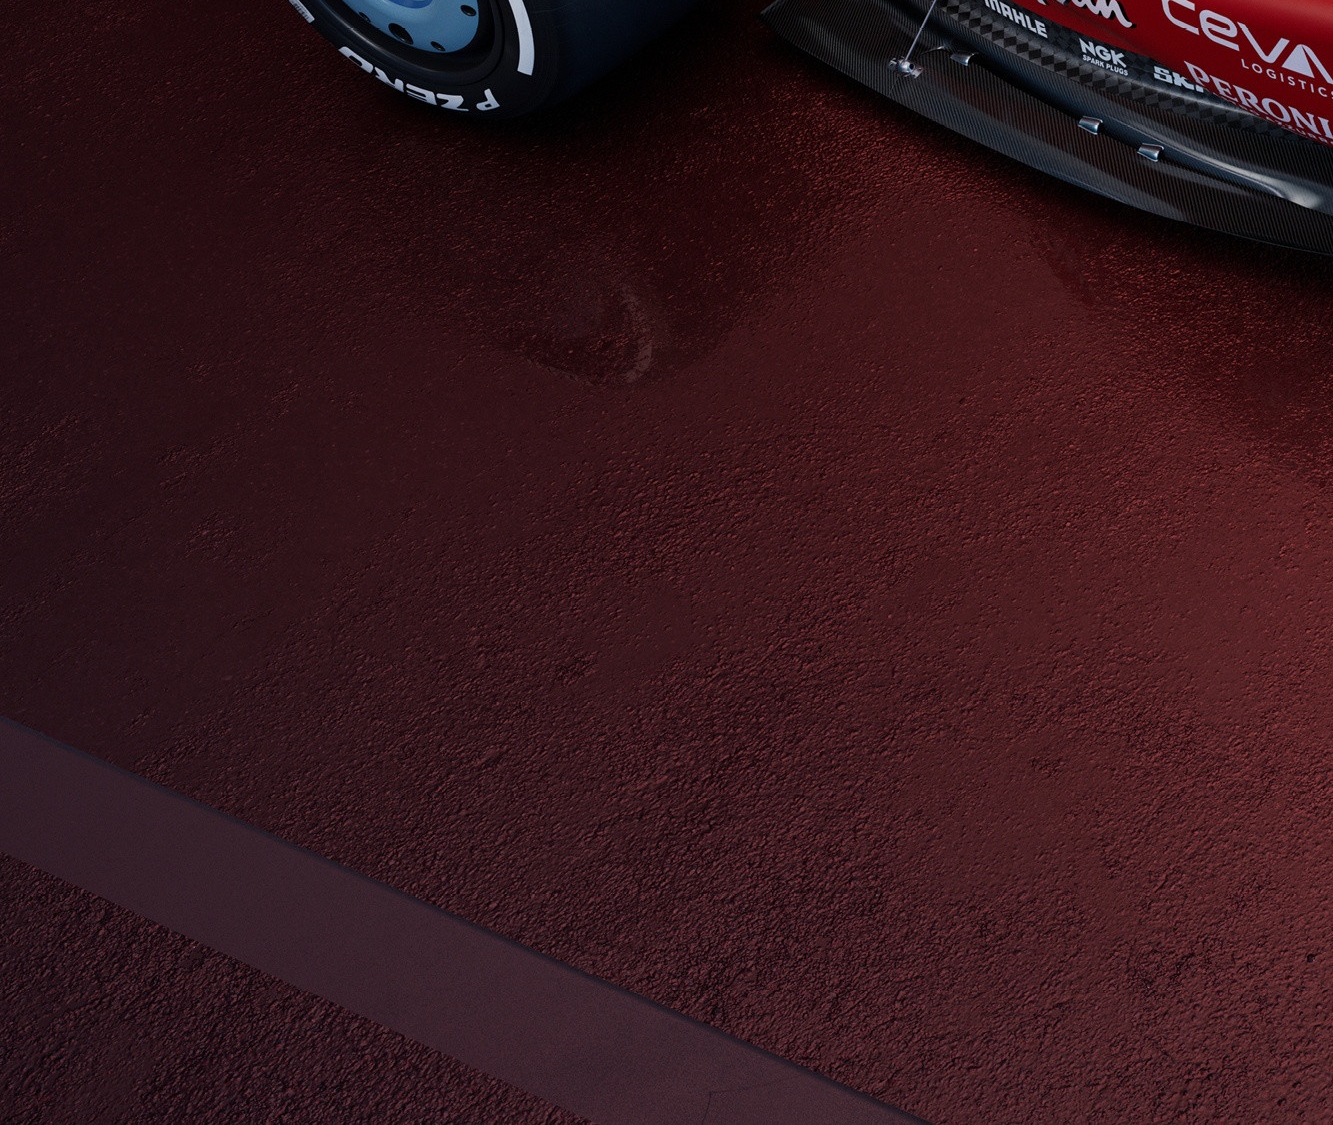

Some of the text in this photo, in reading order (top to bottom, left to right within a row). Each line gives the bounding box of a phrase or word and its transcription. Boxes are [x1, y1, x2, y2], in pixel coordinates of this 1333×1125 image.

[1079, 38, 1127, 68] NGK
[1082, 54, 1129, 76] SPARK PLUGS
[475, 88, 501, 111] P
